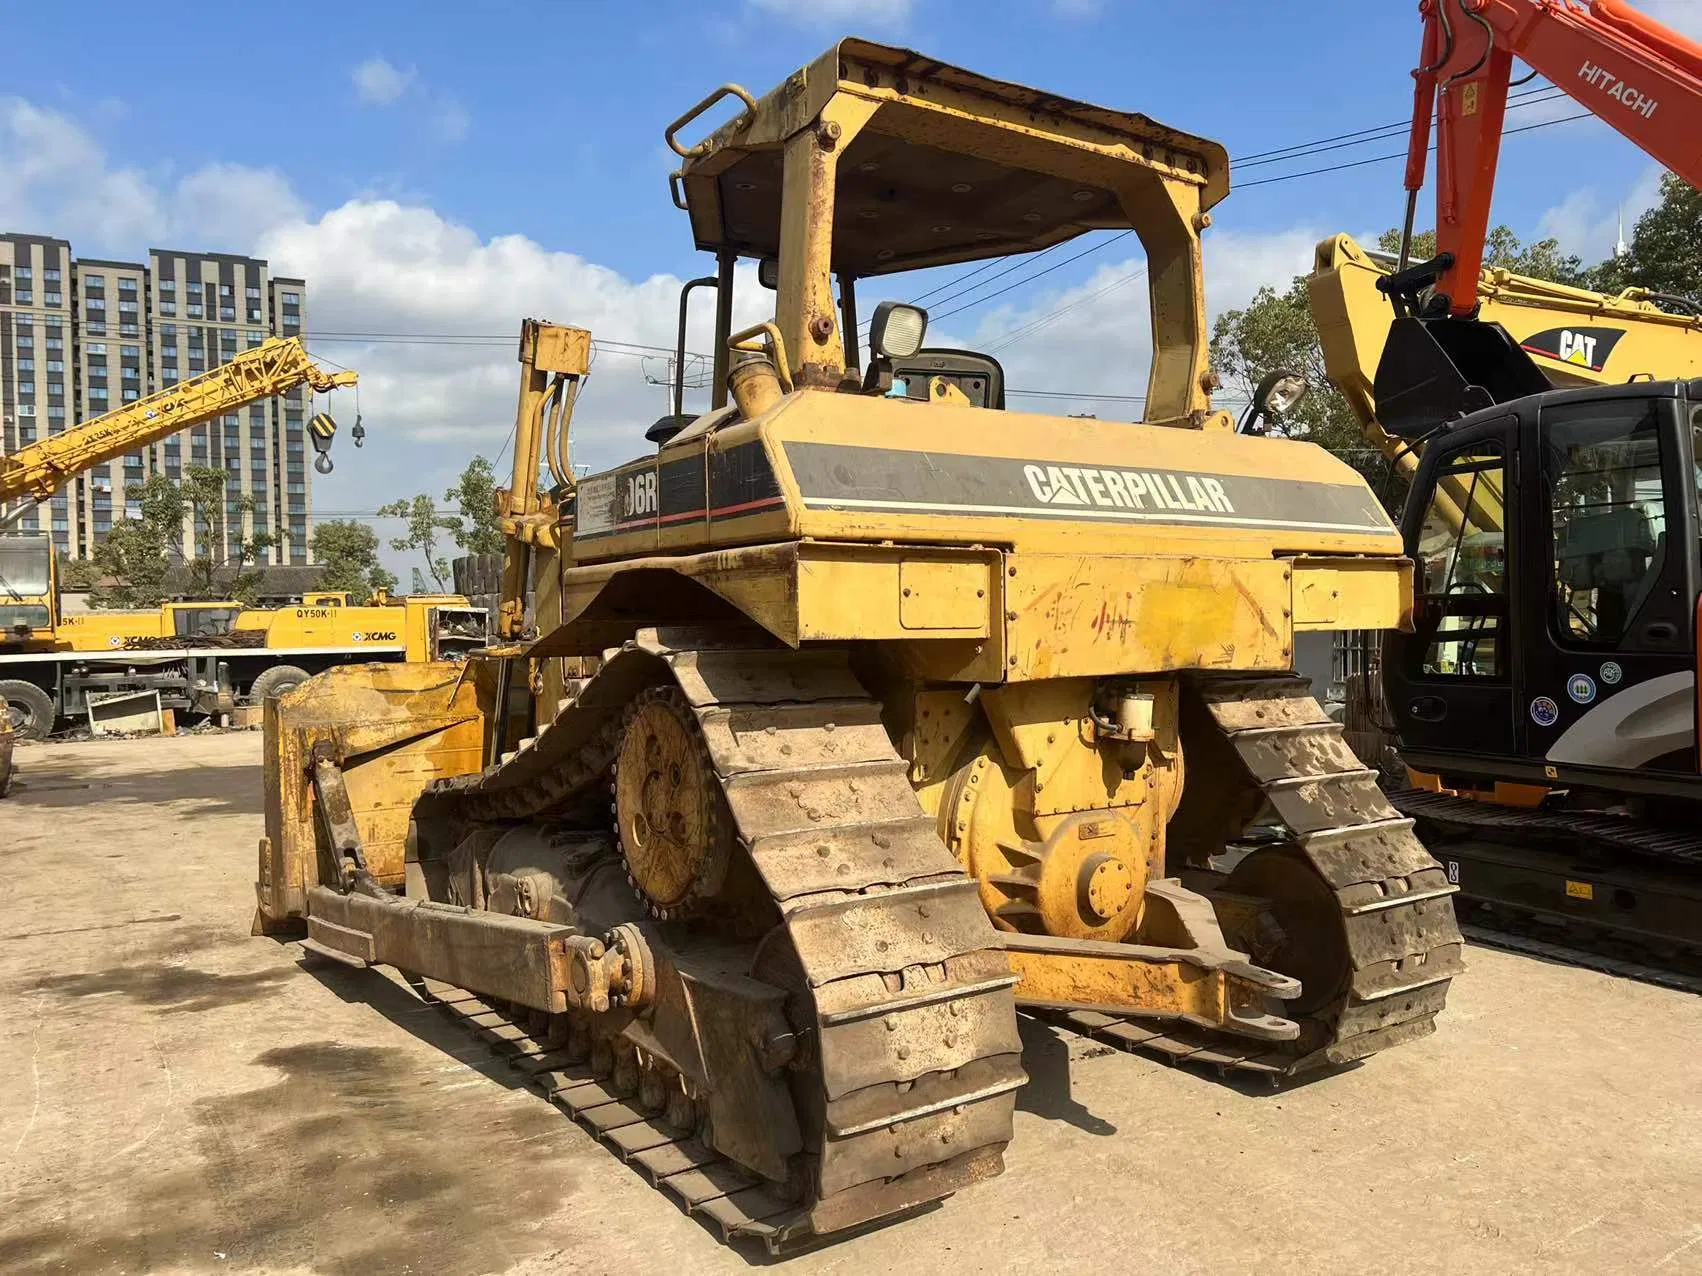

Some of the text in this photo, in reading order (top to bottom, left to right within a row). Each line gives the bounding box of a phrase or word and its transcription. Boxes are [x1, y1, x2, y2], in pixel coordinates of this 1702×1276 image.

[1577, 60, 1658, 119] HITACHI
[1560, 330, 1597, 367] CAT
[1023, 465, 1235, 513] CATERPILLAR
[363, 632, 396, 641] XCMG
